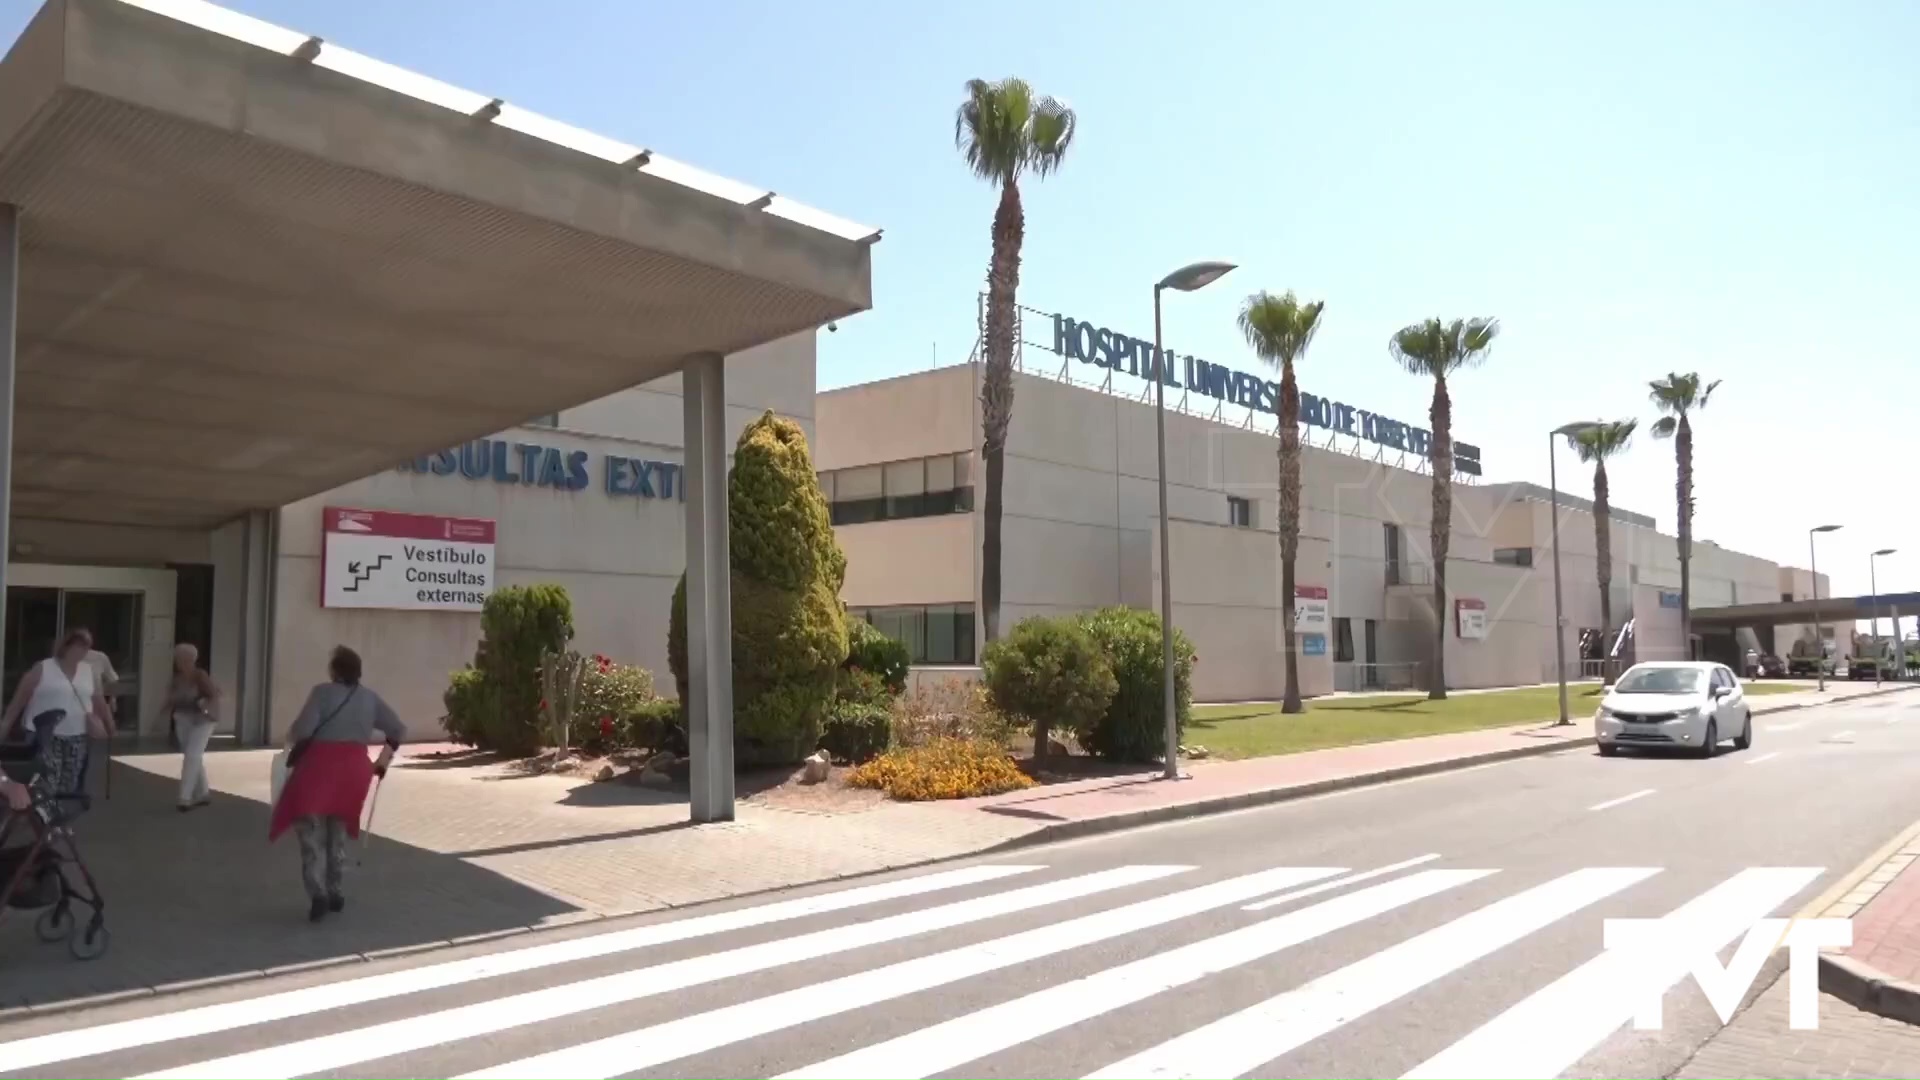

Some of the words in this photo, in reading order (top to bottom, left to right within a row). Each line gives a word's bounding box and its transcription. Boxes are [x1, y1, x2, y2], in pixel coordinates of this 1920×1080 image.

[1054, 313, 1182, 388] HOSPITAL
[605, 455, 685, 501] EXT
[403, 545, 486, 565] Vestíbulo
[405, 567, 486, 587] Consultas
[416, 588, 485, 604] externas
